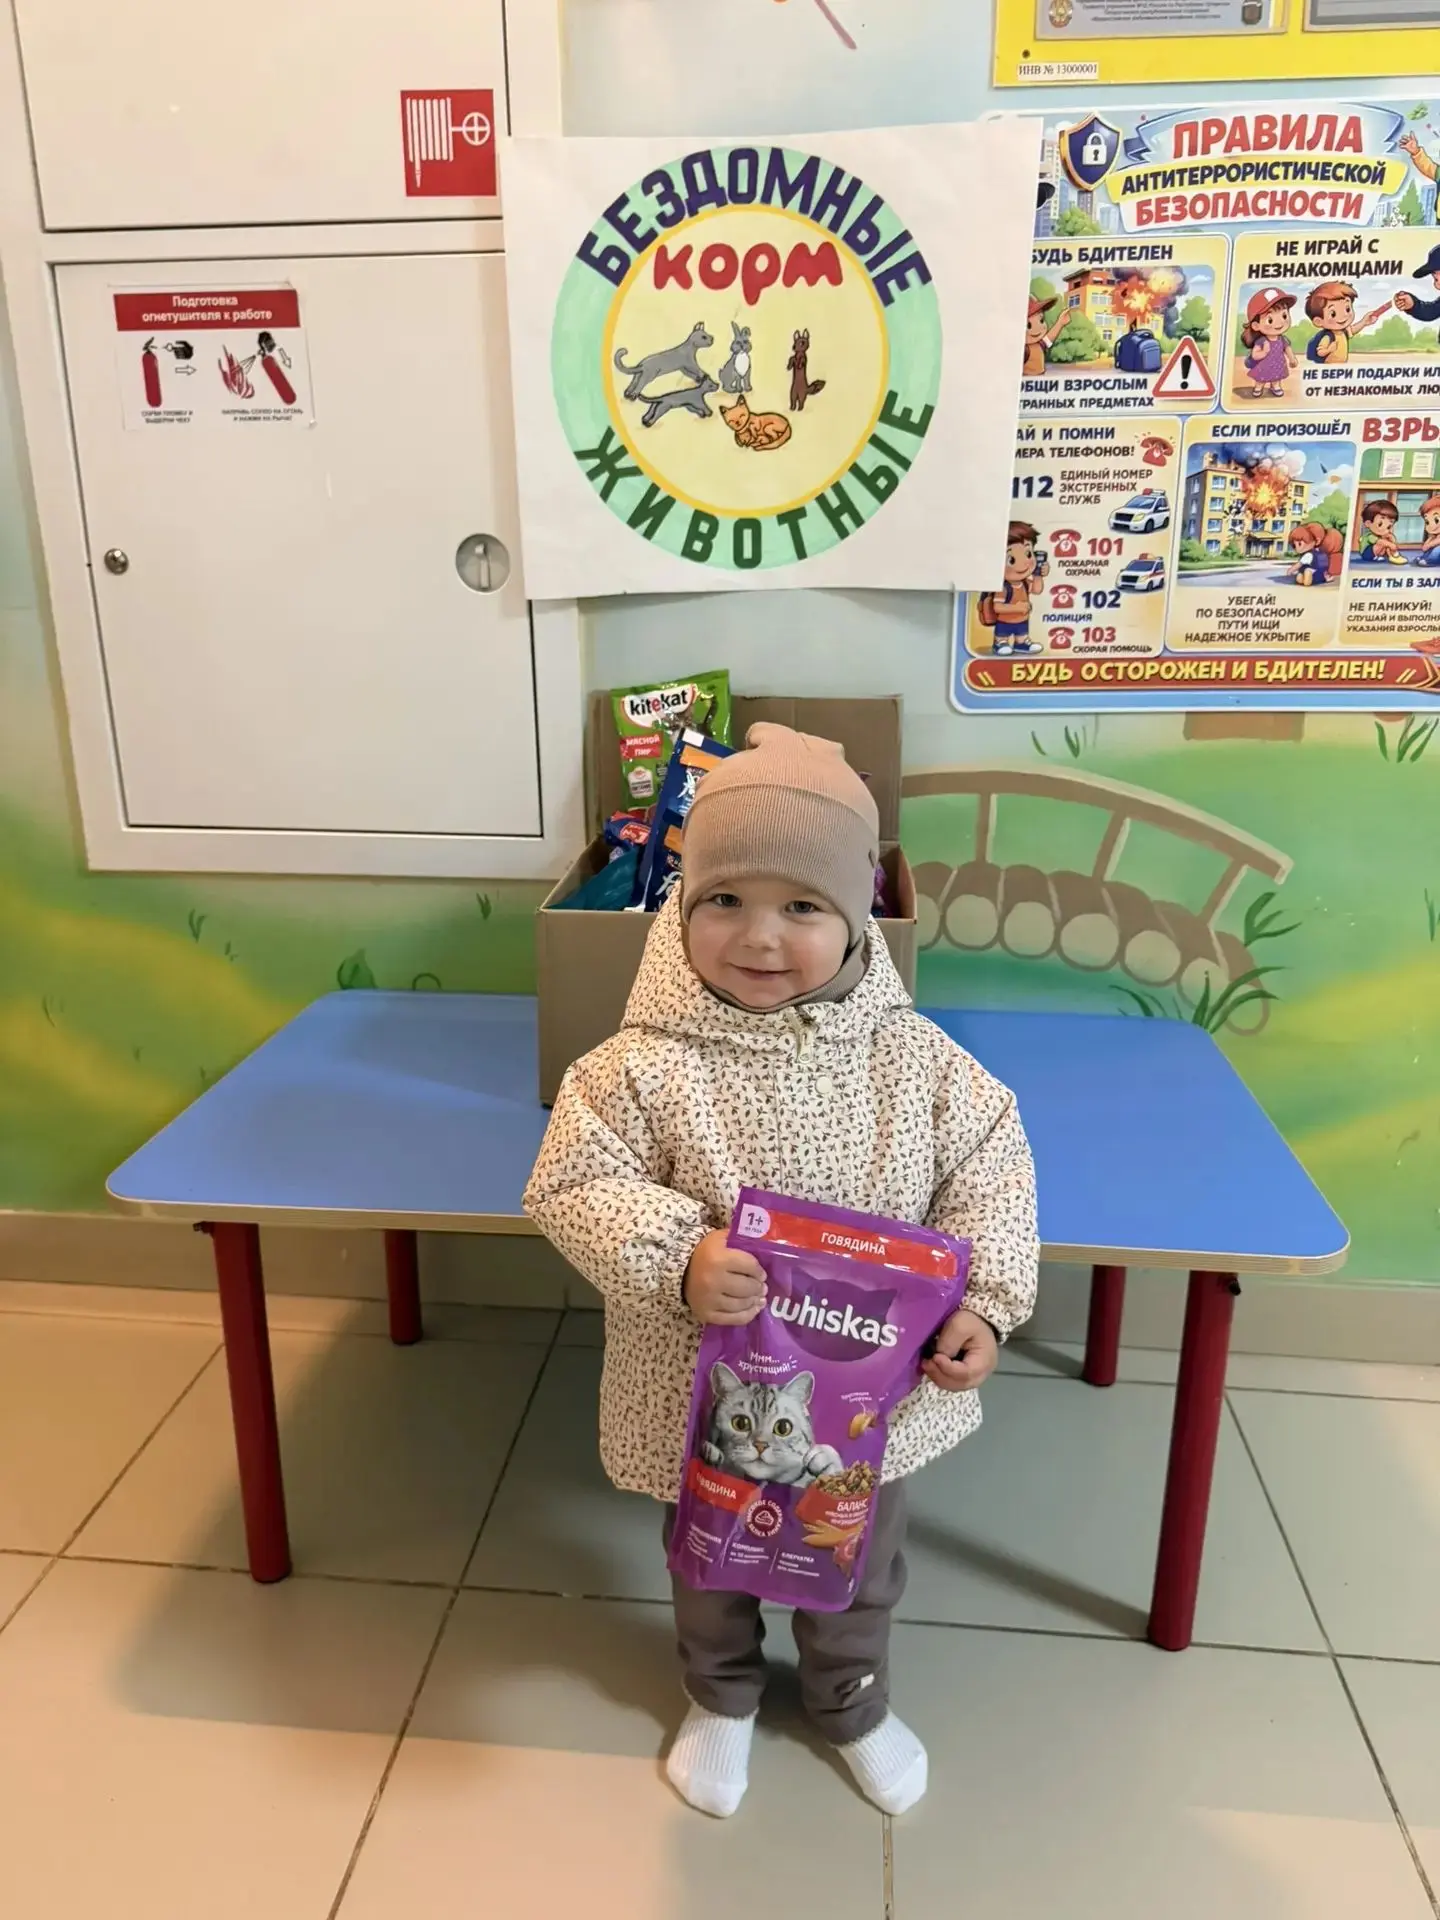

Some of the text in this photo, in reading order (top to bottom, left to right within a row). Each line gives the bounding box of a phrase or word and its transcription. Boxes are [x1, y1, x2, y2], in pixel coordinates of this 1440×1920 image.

[1018, 63, 1098, 76] ИНВ № 13000001
[1173, 115, 1363, 158] ПРАВИЛА
[1121, 161, 1386, 195] АНТИТЕРРОРИСТИЧЕСКОЙ
[1136, 192, 1364, 226] БЕЗОПАСНОСТИ
[576, 147, 933, 308] БЕЗДОМНЫЕ
[1276, 238, 1379, 256] НЕ ИГРАЙ С
[1078, 245, 1172, 264] БДИТЕЛЕН
[1248, 260, 1402, 280] НЕЗНАКОМЦАМИ
[172, 296, 238, 308] Подготовка
[142, 310, 272, 324] огнетушителя к работе
[1303, 370, 1318, 379] НЕ
[1321, 369, 1353, 379] БЕРИ
[1357, 367, 1419, 380] ПОДАРКИ
[1064, 378, 1147, 391] ВЗРОСЛЫМ
[1306, 385, 1440, 396] ОТ НЕЗНАКОМЫХ ЛЮ
[1080, 397, 1154, 408] ПРЕДМЕТАХ
[1043, 428, 1052, 440] И
[1059, 427, 1115, 440] ПОМНИ
[1212, 424, 1252, 437] ЕСЛИ
[1050, 446, 1134, 458] ТЕЛЕФОНОВ!
[574, 390, 935, 570] ЖИВОТНЫЕ
[1060, 468, 1153, 481] ЕДИНЫЙ НОМЕР
[1012, 476, 1053, 499] 112
[1060, 482, 1137, 493] ЭКСТРЕННЫХ
[1059, 494, 1100, 505] СЛУЖБ
[1088, 538, 1124, 556] 101
[1058, 560, 1109, 568] ПОЖАРНАЯ
[1352, 578, 1440, 588] ЕСЛИ ТЫ В ЗАЛ
[1082, 590, 1120, 608] 102
[1228, 593, 1276, 606] УБЕГАЙ!
[1349, 600, 1432, 612] НЕ ПАНИКУЙ!
[1042, 614, 1092, 623] ПОЛИЦИЯ
[1196, 608, 1304, 618] ПО БЕЗОПАСНОМУ
[1347, 614, 1387, 622] СЛУШАЙ
[1218, 620, 1280, 631] ПУТИ ИЩИ
[1082, 627, 1116, 643] 103
[1185, 632, 1310, 643] НАДЕЖНОЕ УКРЫТИЕ
[1109, 645, 1152, 653] ПОМОЩЬ
[1011, 659, 1384, 682] БУДЬ ОСТОРОЖЕН И БДИТЕЛЕН!
[630, 690, 688, 716] kitekat
[747, 1212, 763, 1226] 1+
[820, 1232, 886, 1256] ГОВЯДИНА
[770, 1294, 898, 1347] whiskas
[738, 1360, 791, 1375] хрустящий!
